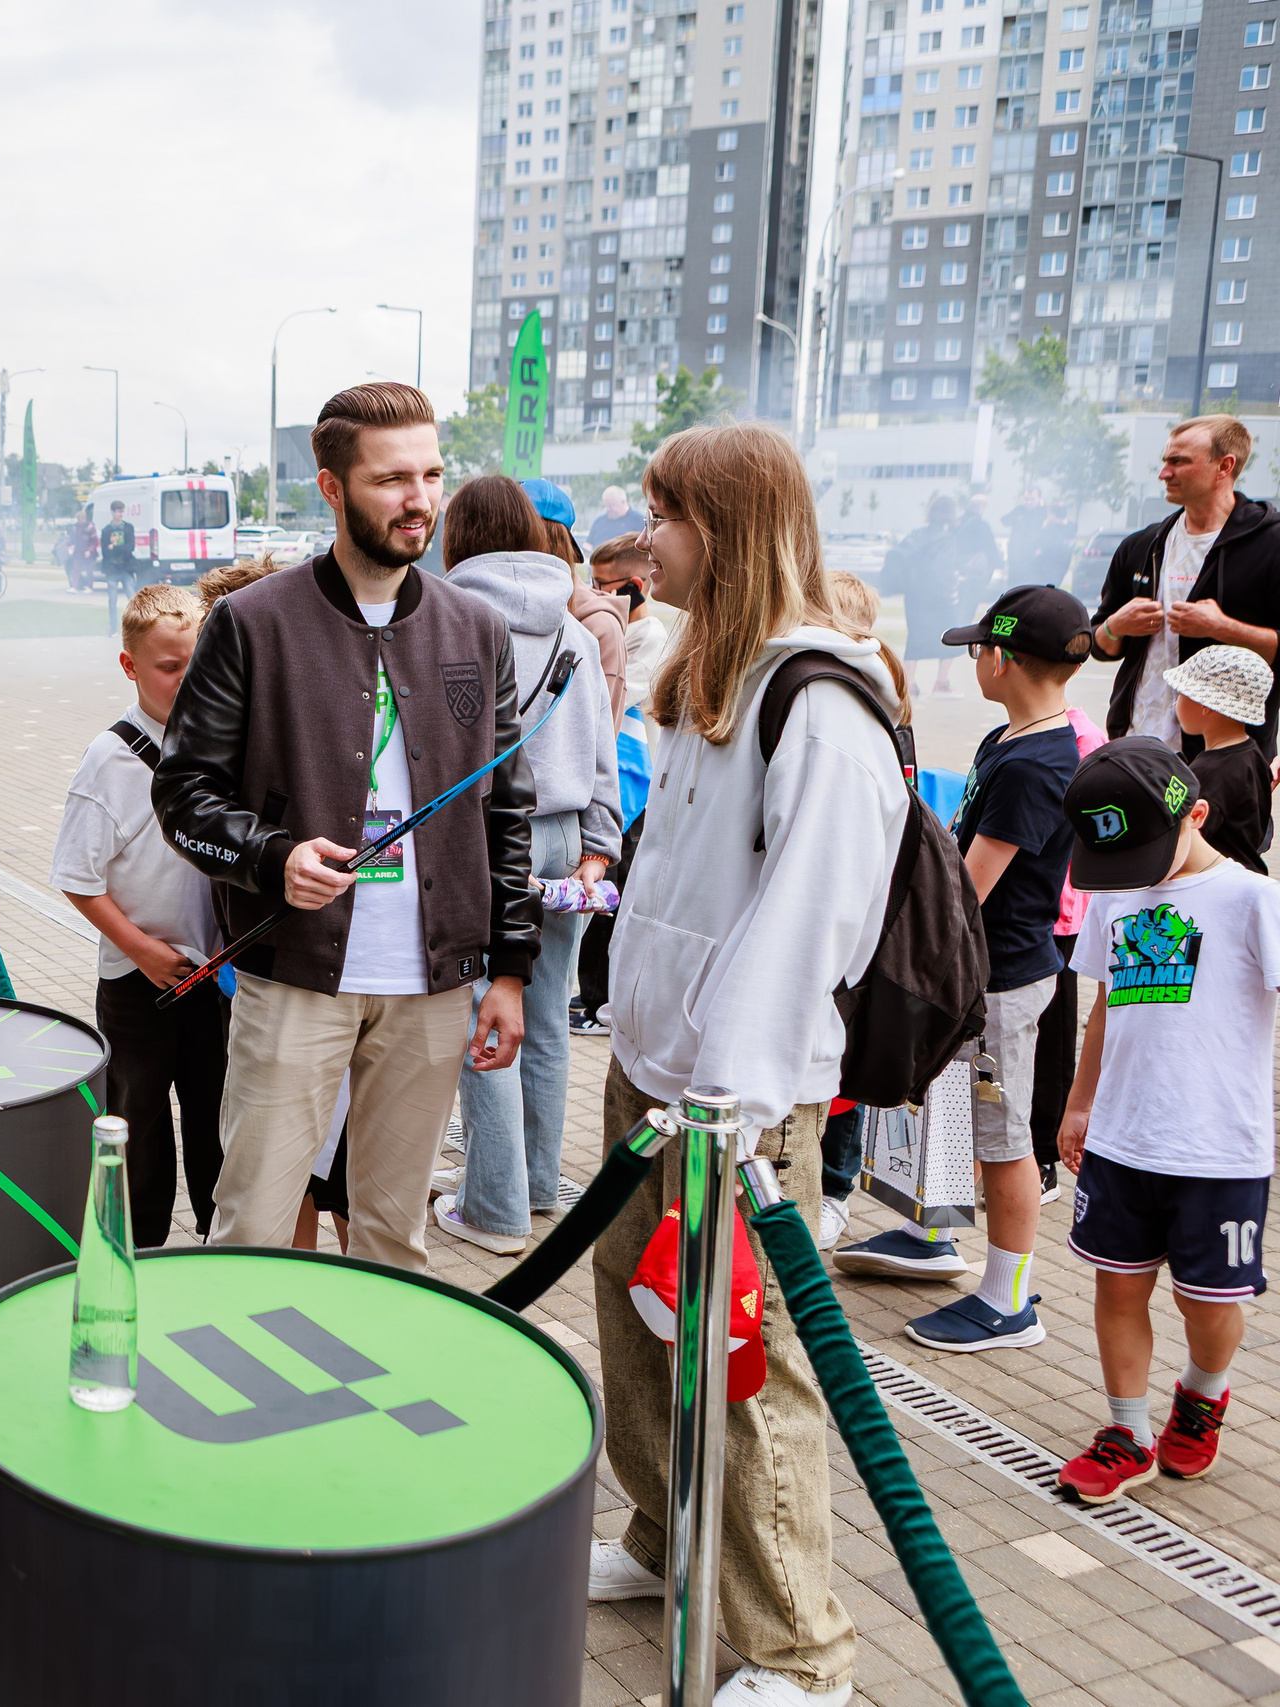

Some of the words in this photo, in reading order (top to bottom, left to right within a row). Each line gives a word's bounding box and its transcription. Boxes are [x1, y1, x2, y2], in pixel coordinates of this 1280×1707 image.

[512, 358, 539, 480] ERA
[992, 615, 1018, 636] 92
[1165, 776, 1188, 814] 29
[175, 829, 239, 864] HOCKEY.BY
[1113, 965, 1194, 990] DINAMO
[1220, 1220, 1258, 1268] 10
[749, 1289, 758, 1318] adidas
